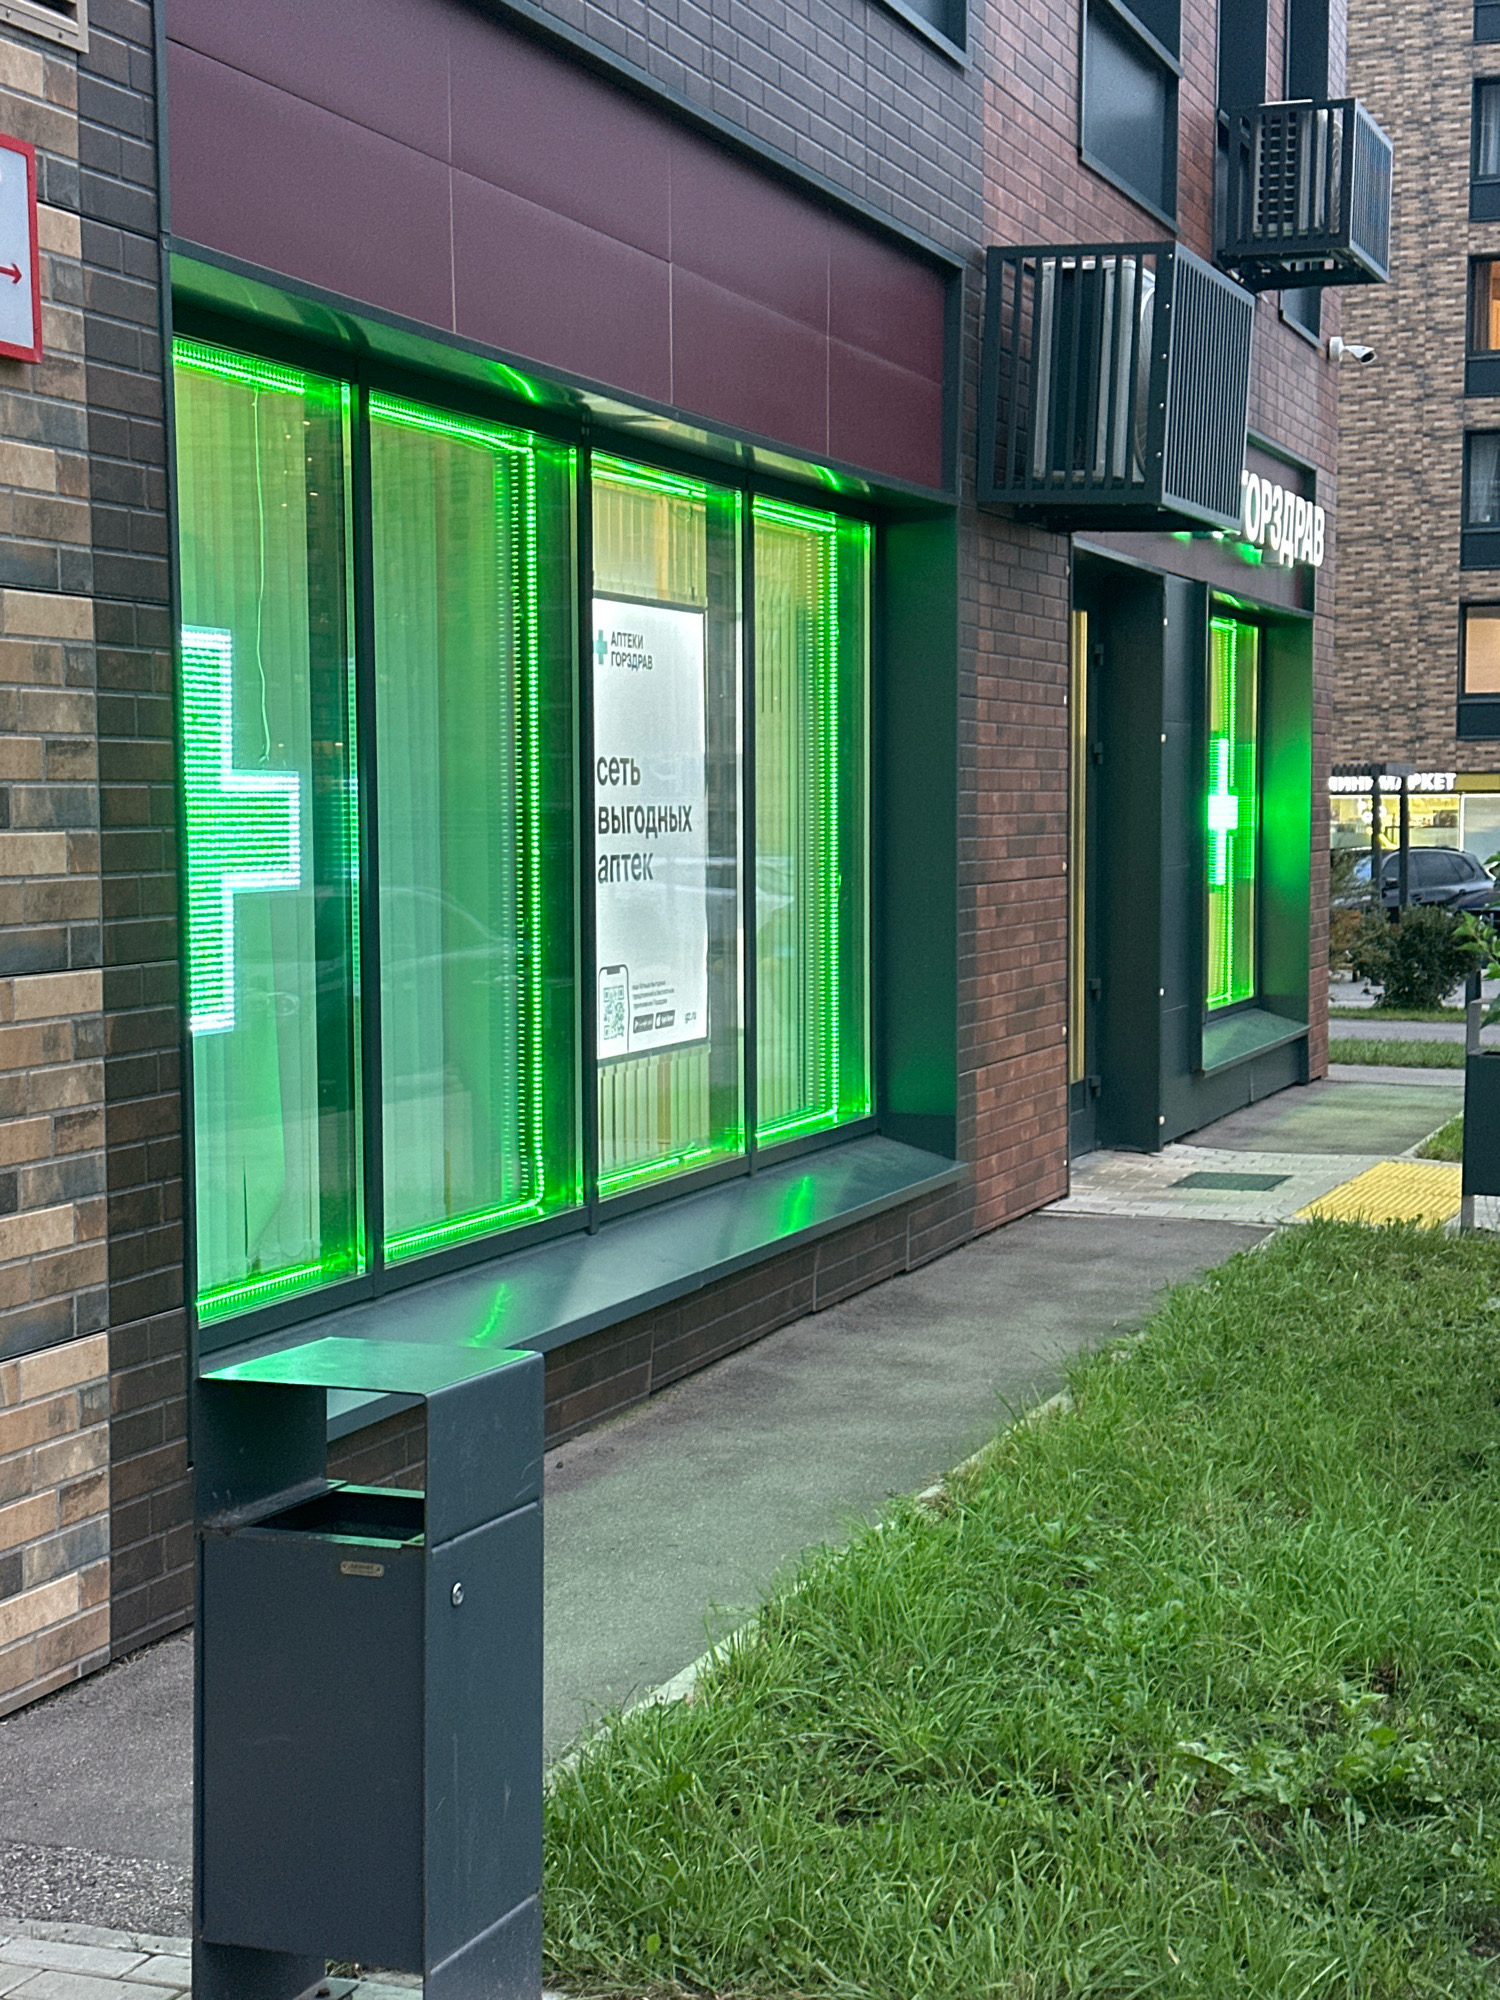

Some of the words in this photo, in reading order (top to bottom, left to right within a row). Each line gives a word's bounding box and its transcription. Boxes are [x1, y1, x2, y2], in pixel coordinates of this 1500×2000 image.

[611, 631, 644, 649] АПТЕКИ
[611, 651, 653, 671] ГОРЗДРАВ
[597, 756, 641, 786] сеть
[598, 805, 692, 839] выгодных
[598, 853, 653, 884] аптек
